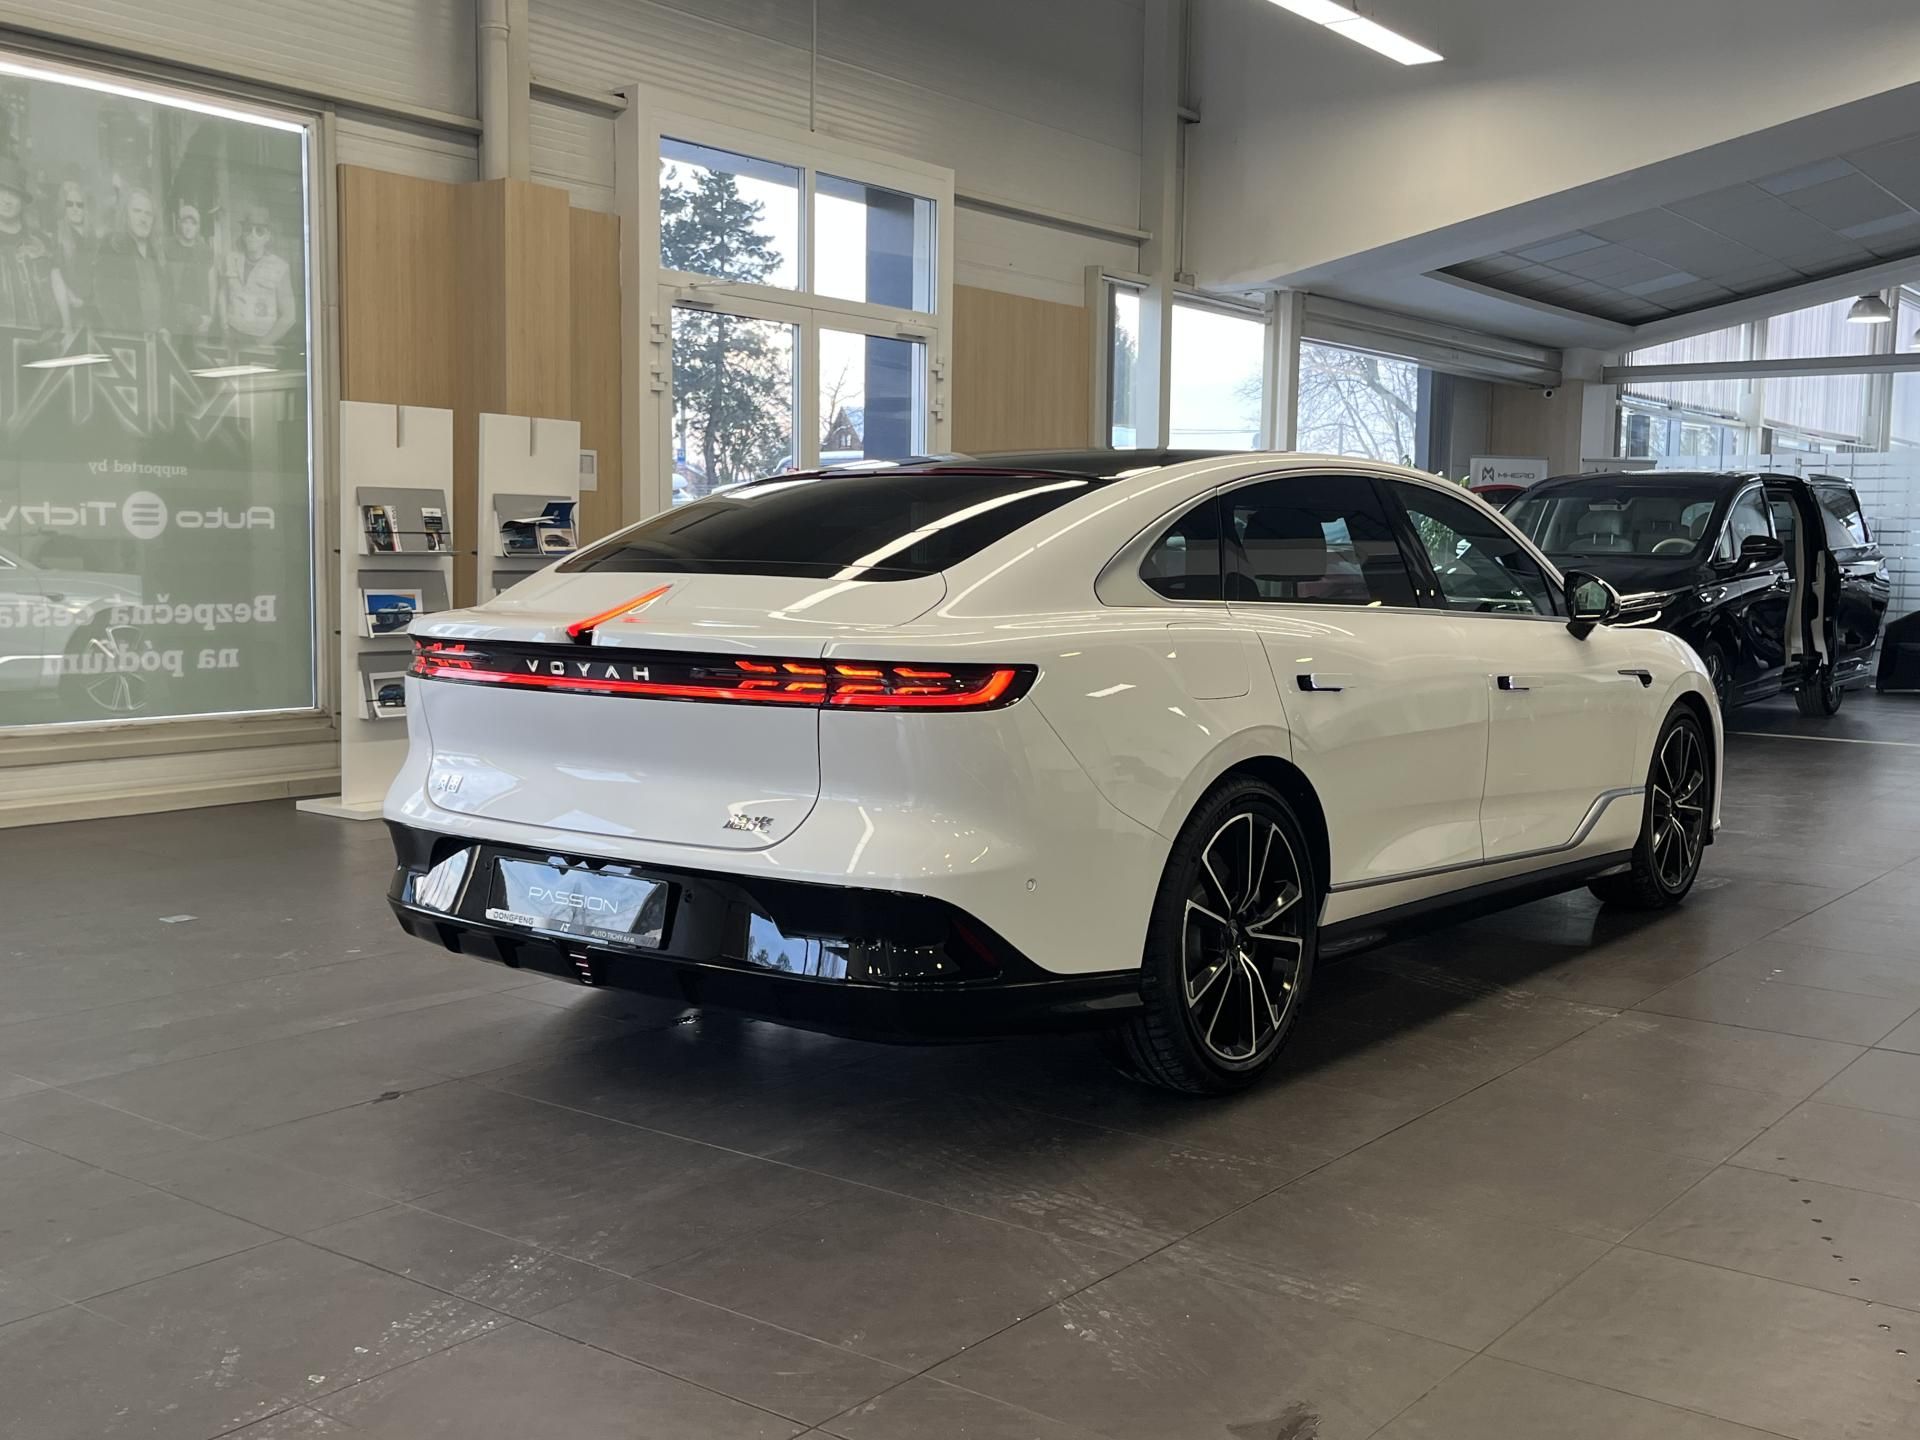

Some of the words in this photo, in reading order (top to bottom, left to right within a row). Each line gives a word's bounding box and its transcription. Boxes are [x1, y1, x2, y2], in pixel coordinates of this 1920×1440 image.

[526, 659, 650, 681] VOYAH
[528, 886, 619, 914] PASSION
[493, 911, 534, 925] DONGFENG
[591, 929, 607, 938] AUTO
